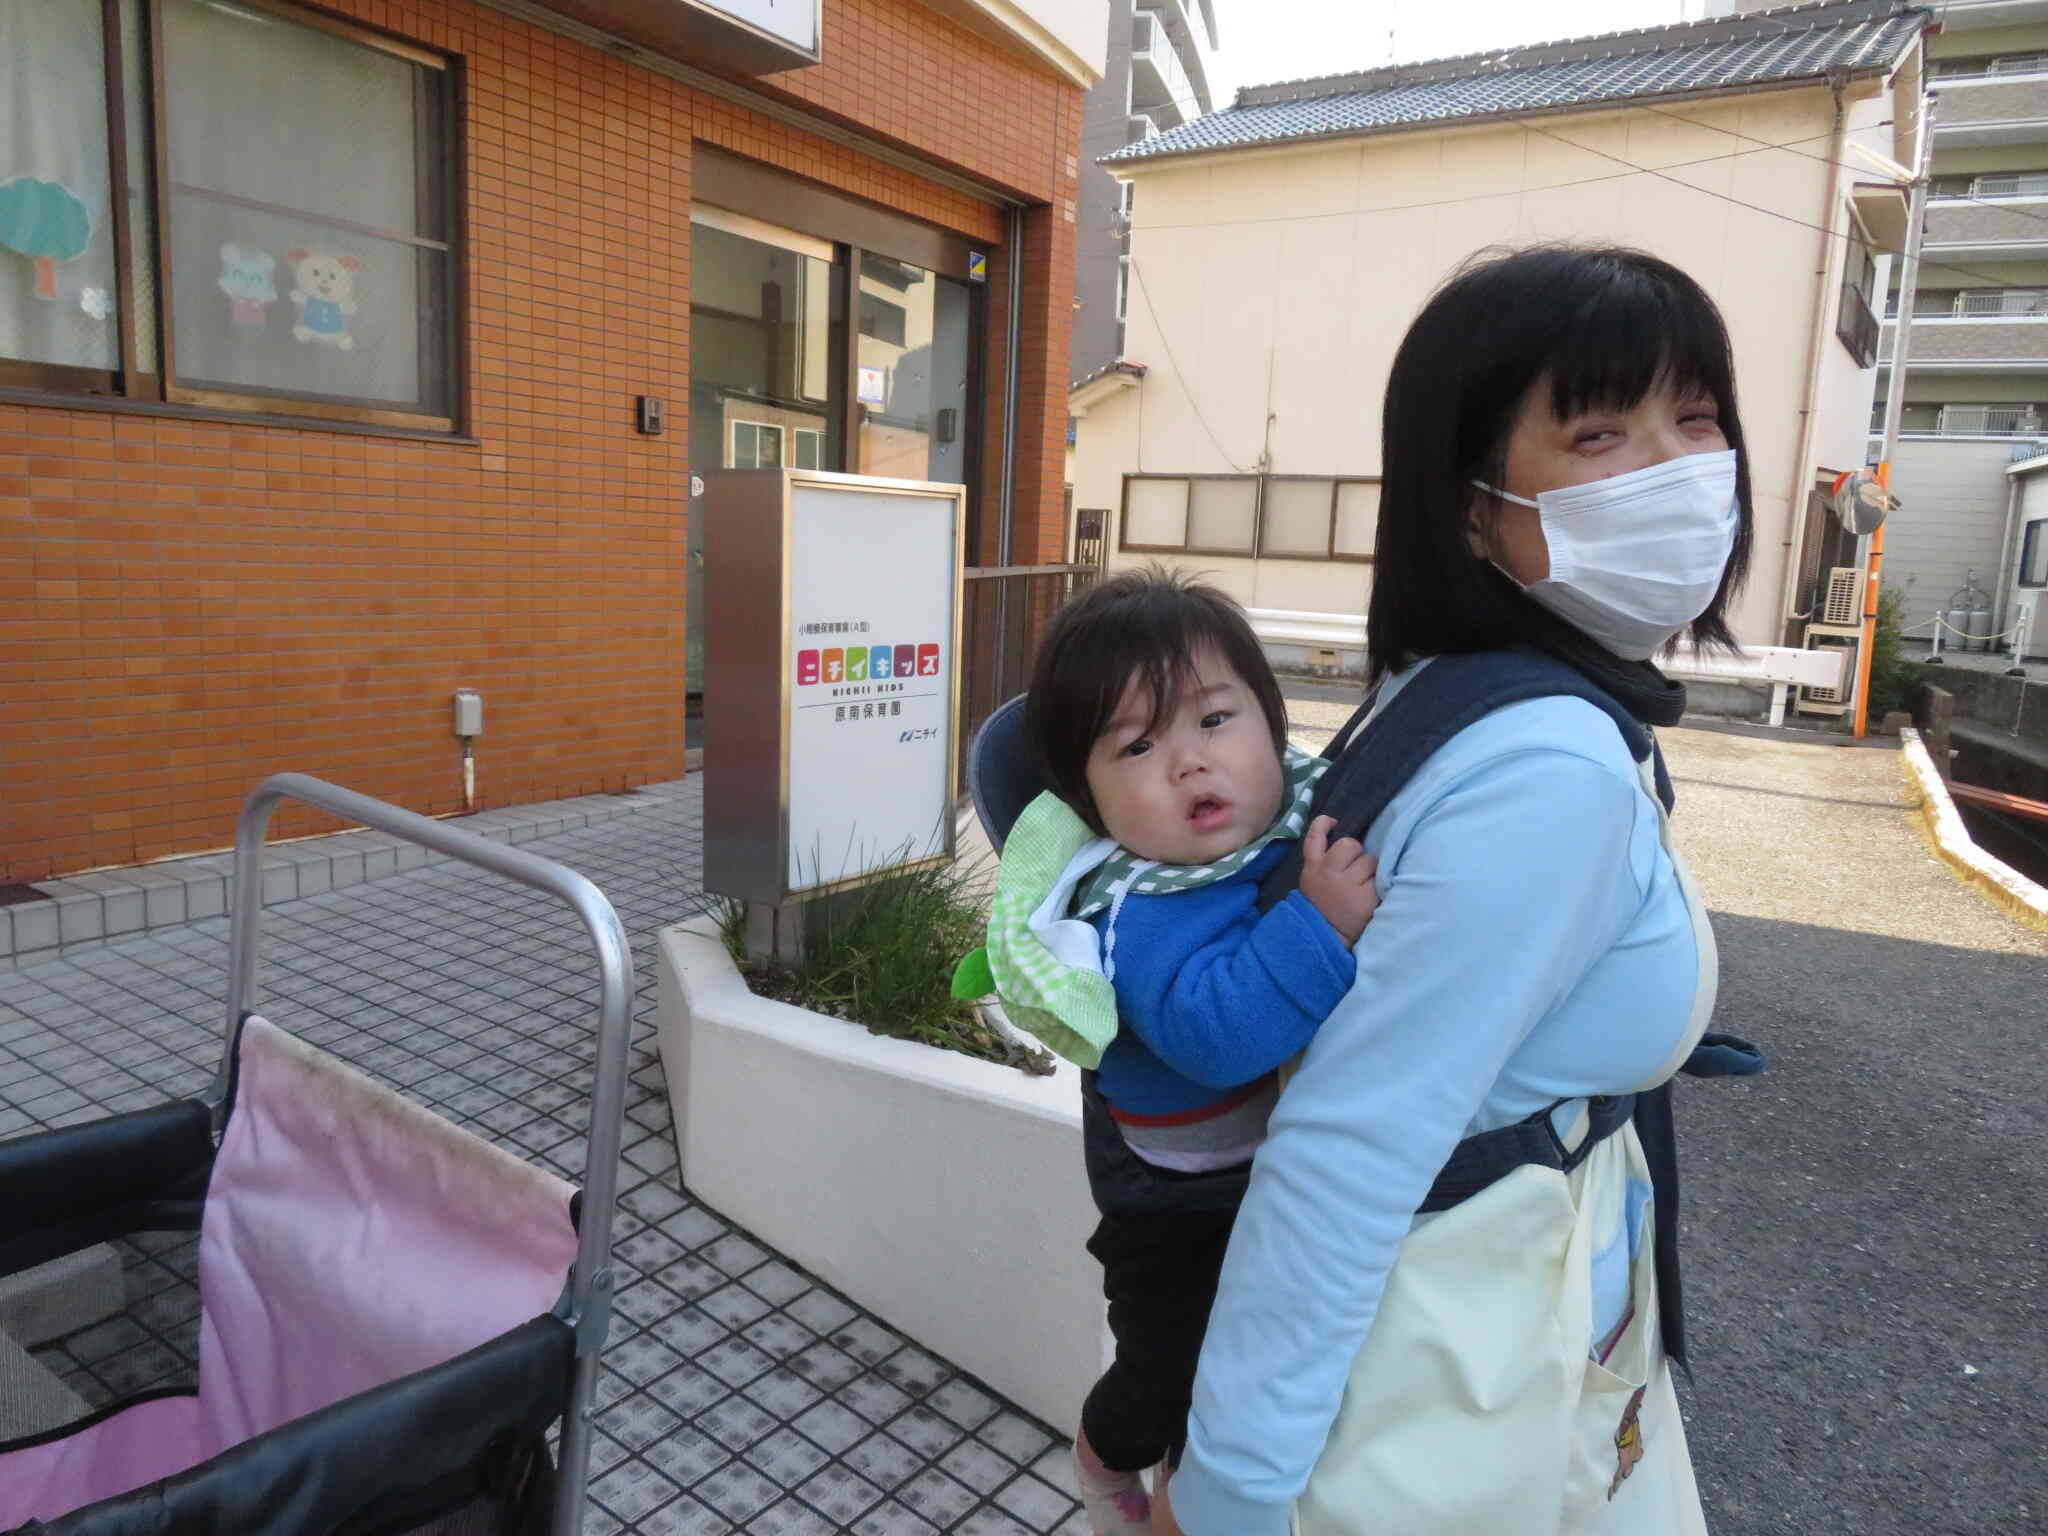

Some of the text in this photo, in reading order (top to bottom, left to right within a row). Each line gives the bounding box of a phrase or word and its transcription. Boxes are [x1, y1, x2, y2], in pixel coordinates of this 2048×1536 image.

[800, 649, 939, 684] ニチイキッズ
[832, 682, 904, 697] NICHII KIDS
[912, 727, 938, 741] ニチイ
